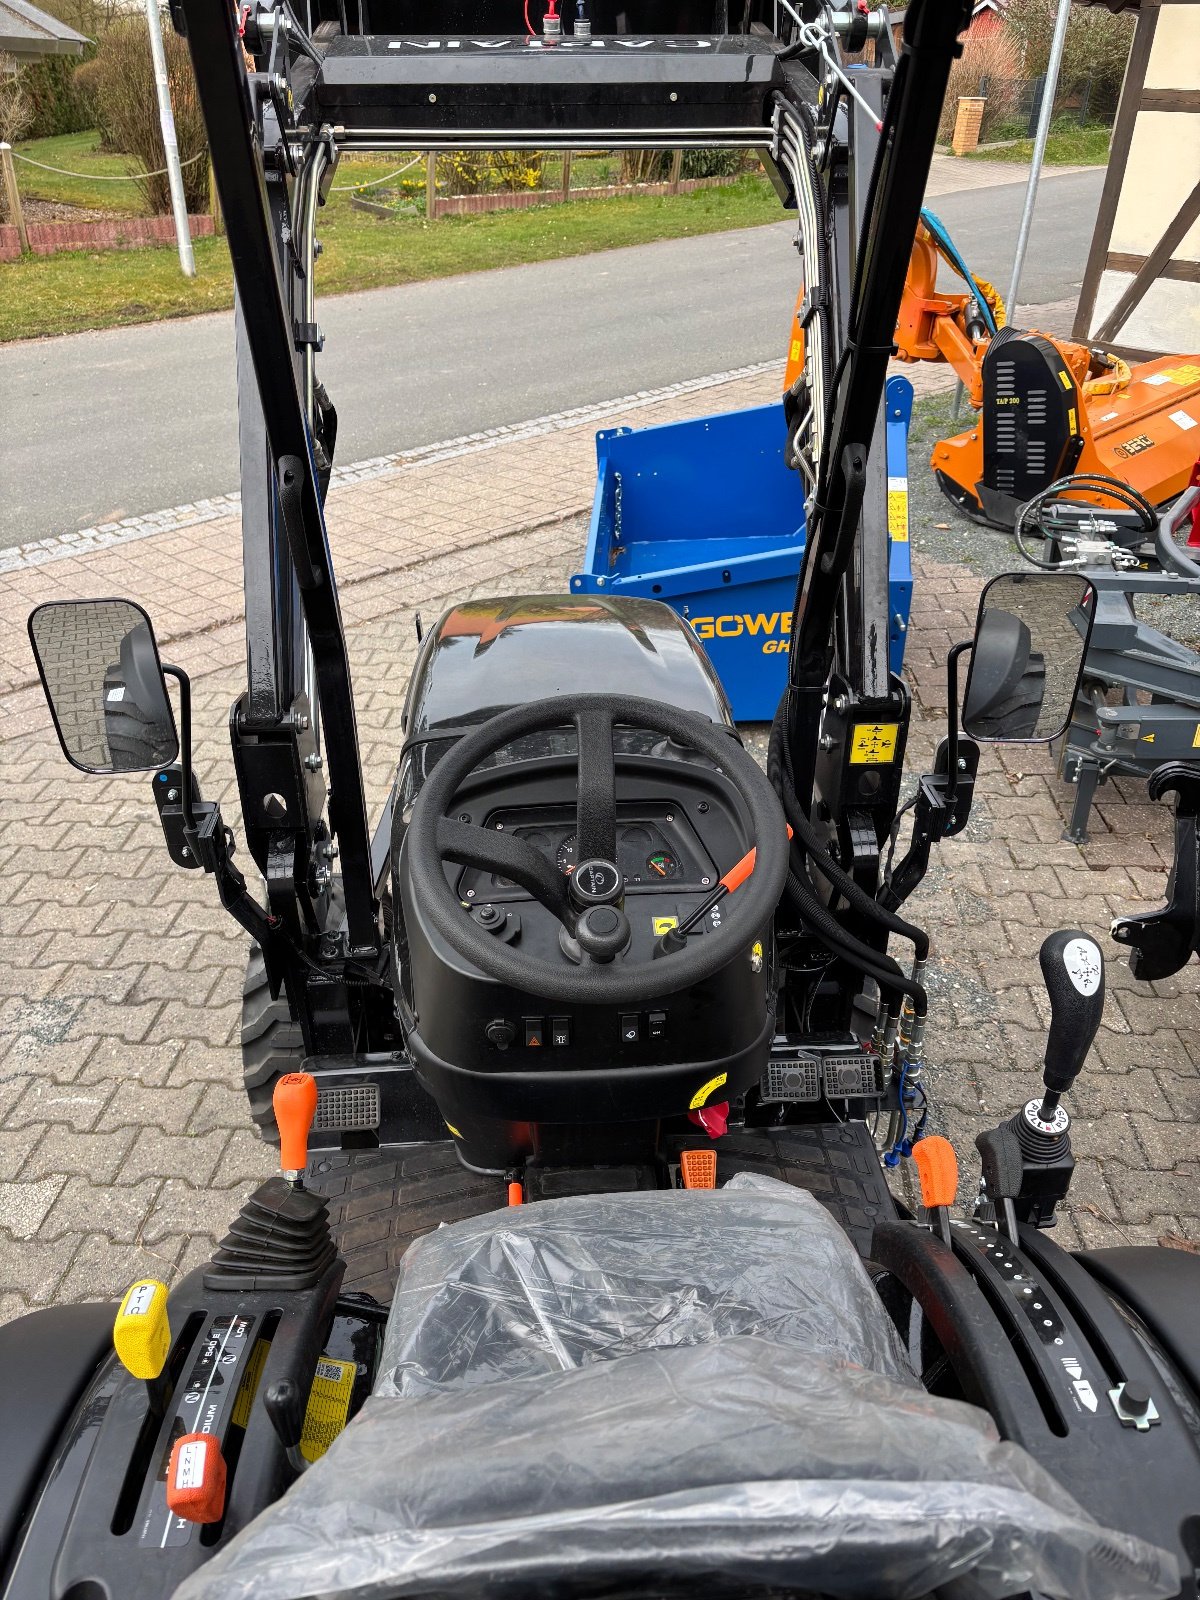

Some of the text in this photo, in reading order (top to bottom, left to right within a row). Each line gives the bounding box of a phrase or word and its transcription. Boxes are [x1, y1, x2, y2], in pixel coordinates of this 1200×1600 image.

[387, 38, 712, 49] CAPTAIN
[588, 866, 597, 893] CAPTAIN
[1026, 1102, 1044, 1129] PULL
[1055, 1105, 1067, 1129] PUS
[235, 1321, 248, 1338] LOW
[202, 1404, 218, 1434] DIUM
